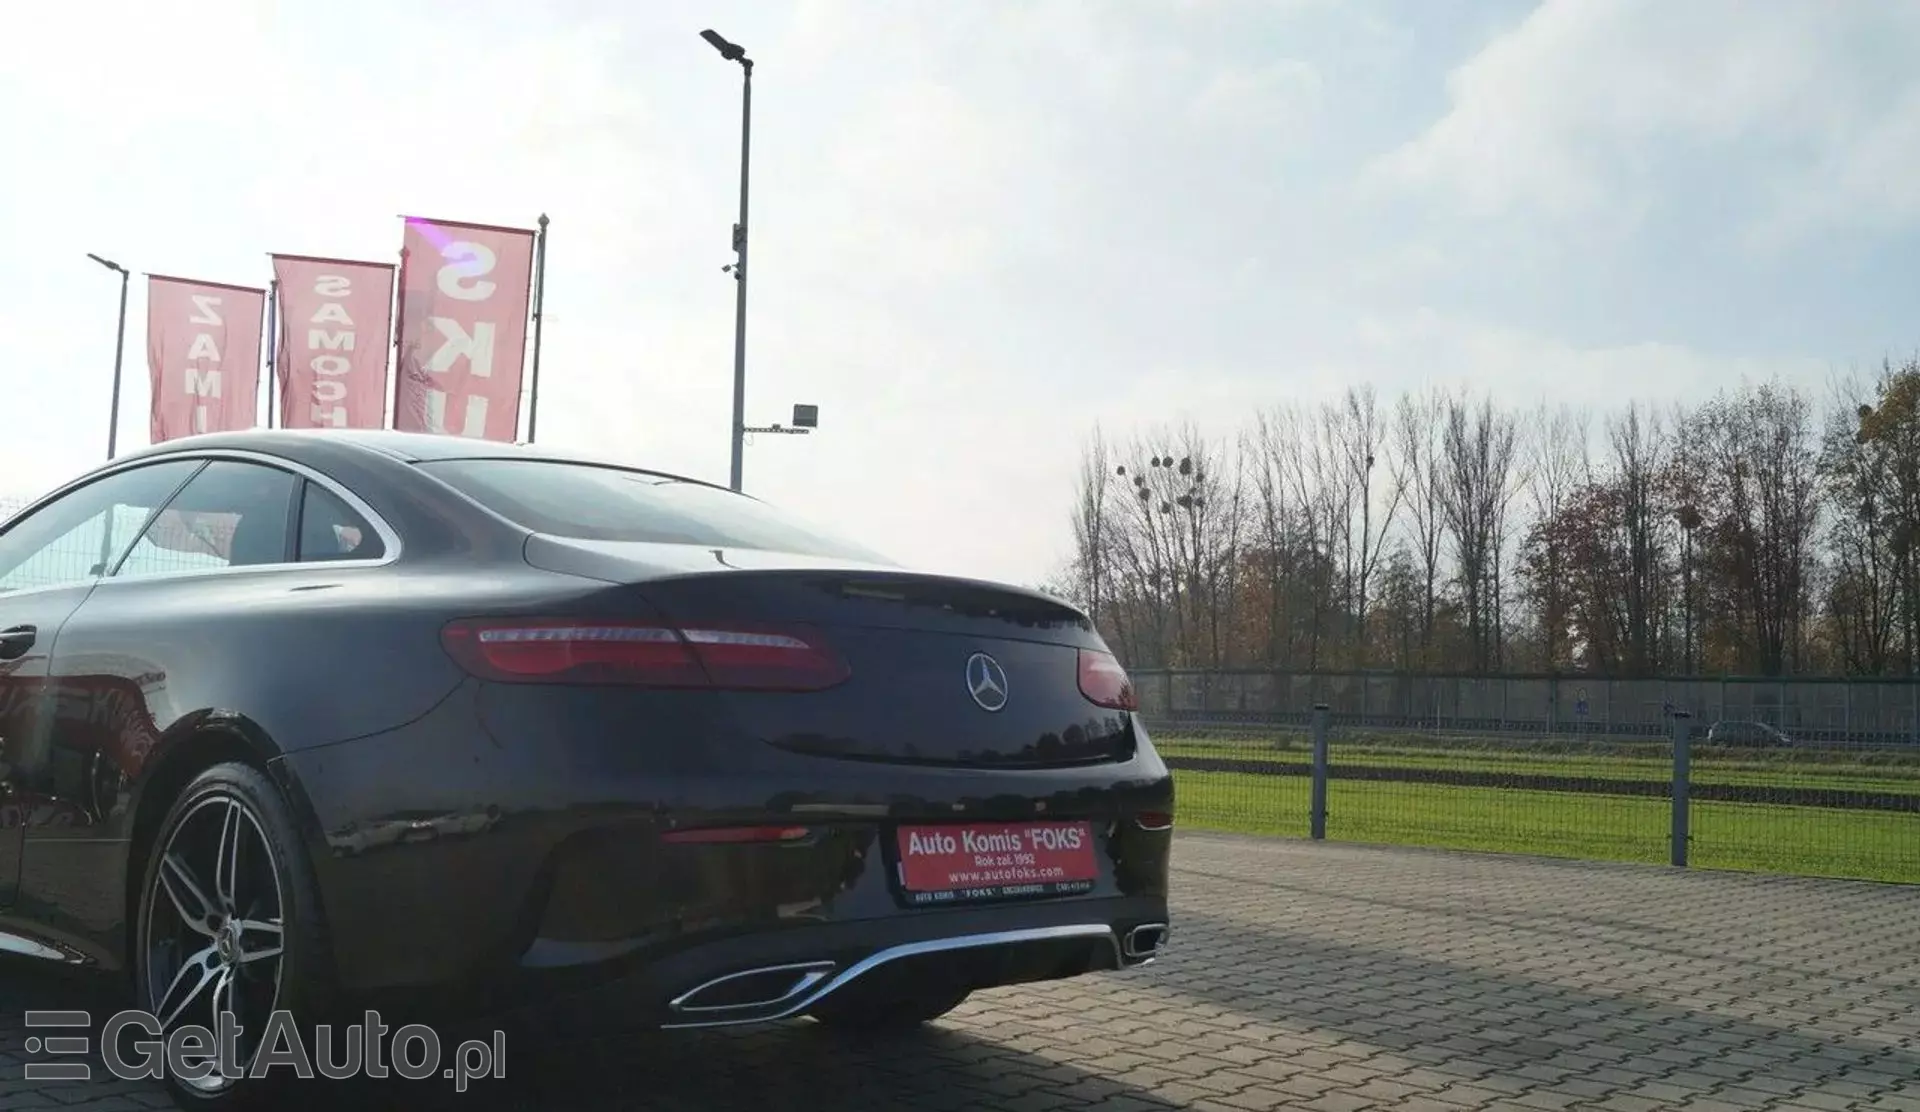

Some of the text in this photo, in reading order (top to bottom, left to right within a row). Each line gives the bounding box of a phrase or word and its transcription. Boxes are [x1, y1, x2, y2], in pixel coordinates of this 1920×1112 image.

[908, 828, 1086, 855] Auto Komis "FOKS"
[974, 855, 994, 867] Rok
[1014, 852, 1036, 865] 1992
[949, 866, 1064, 883] www.autofoks.com
